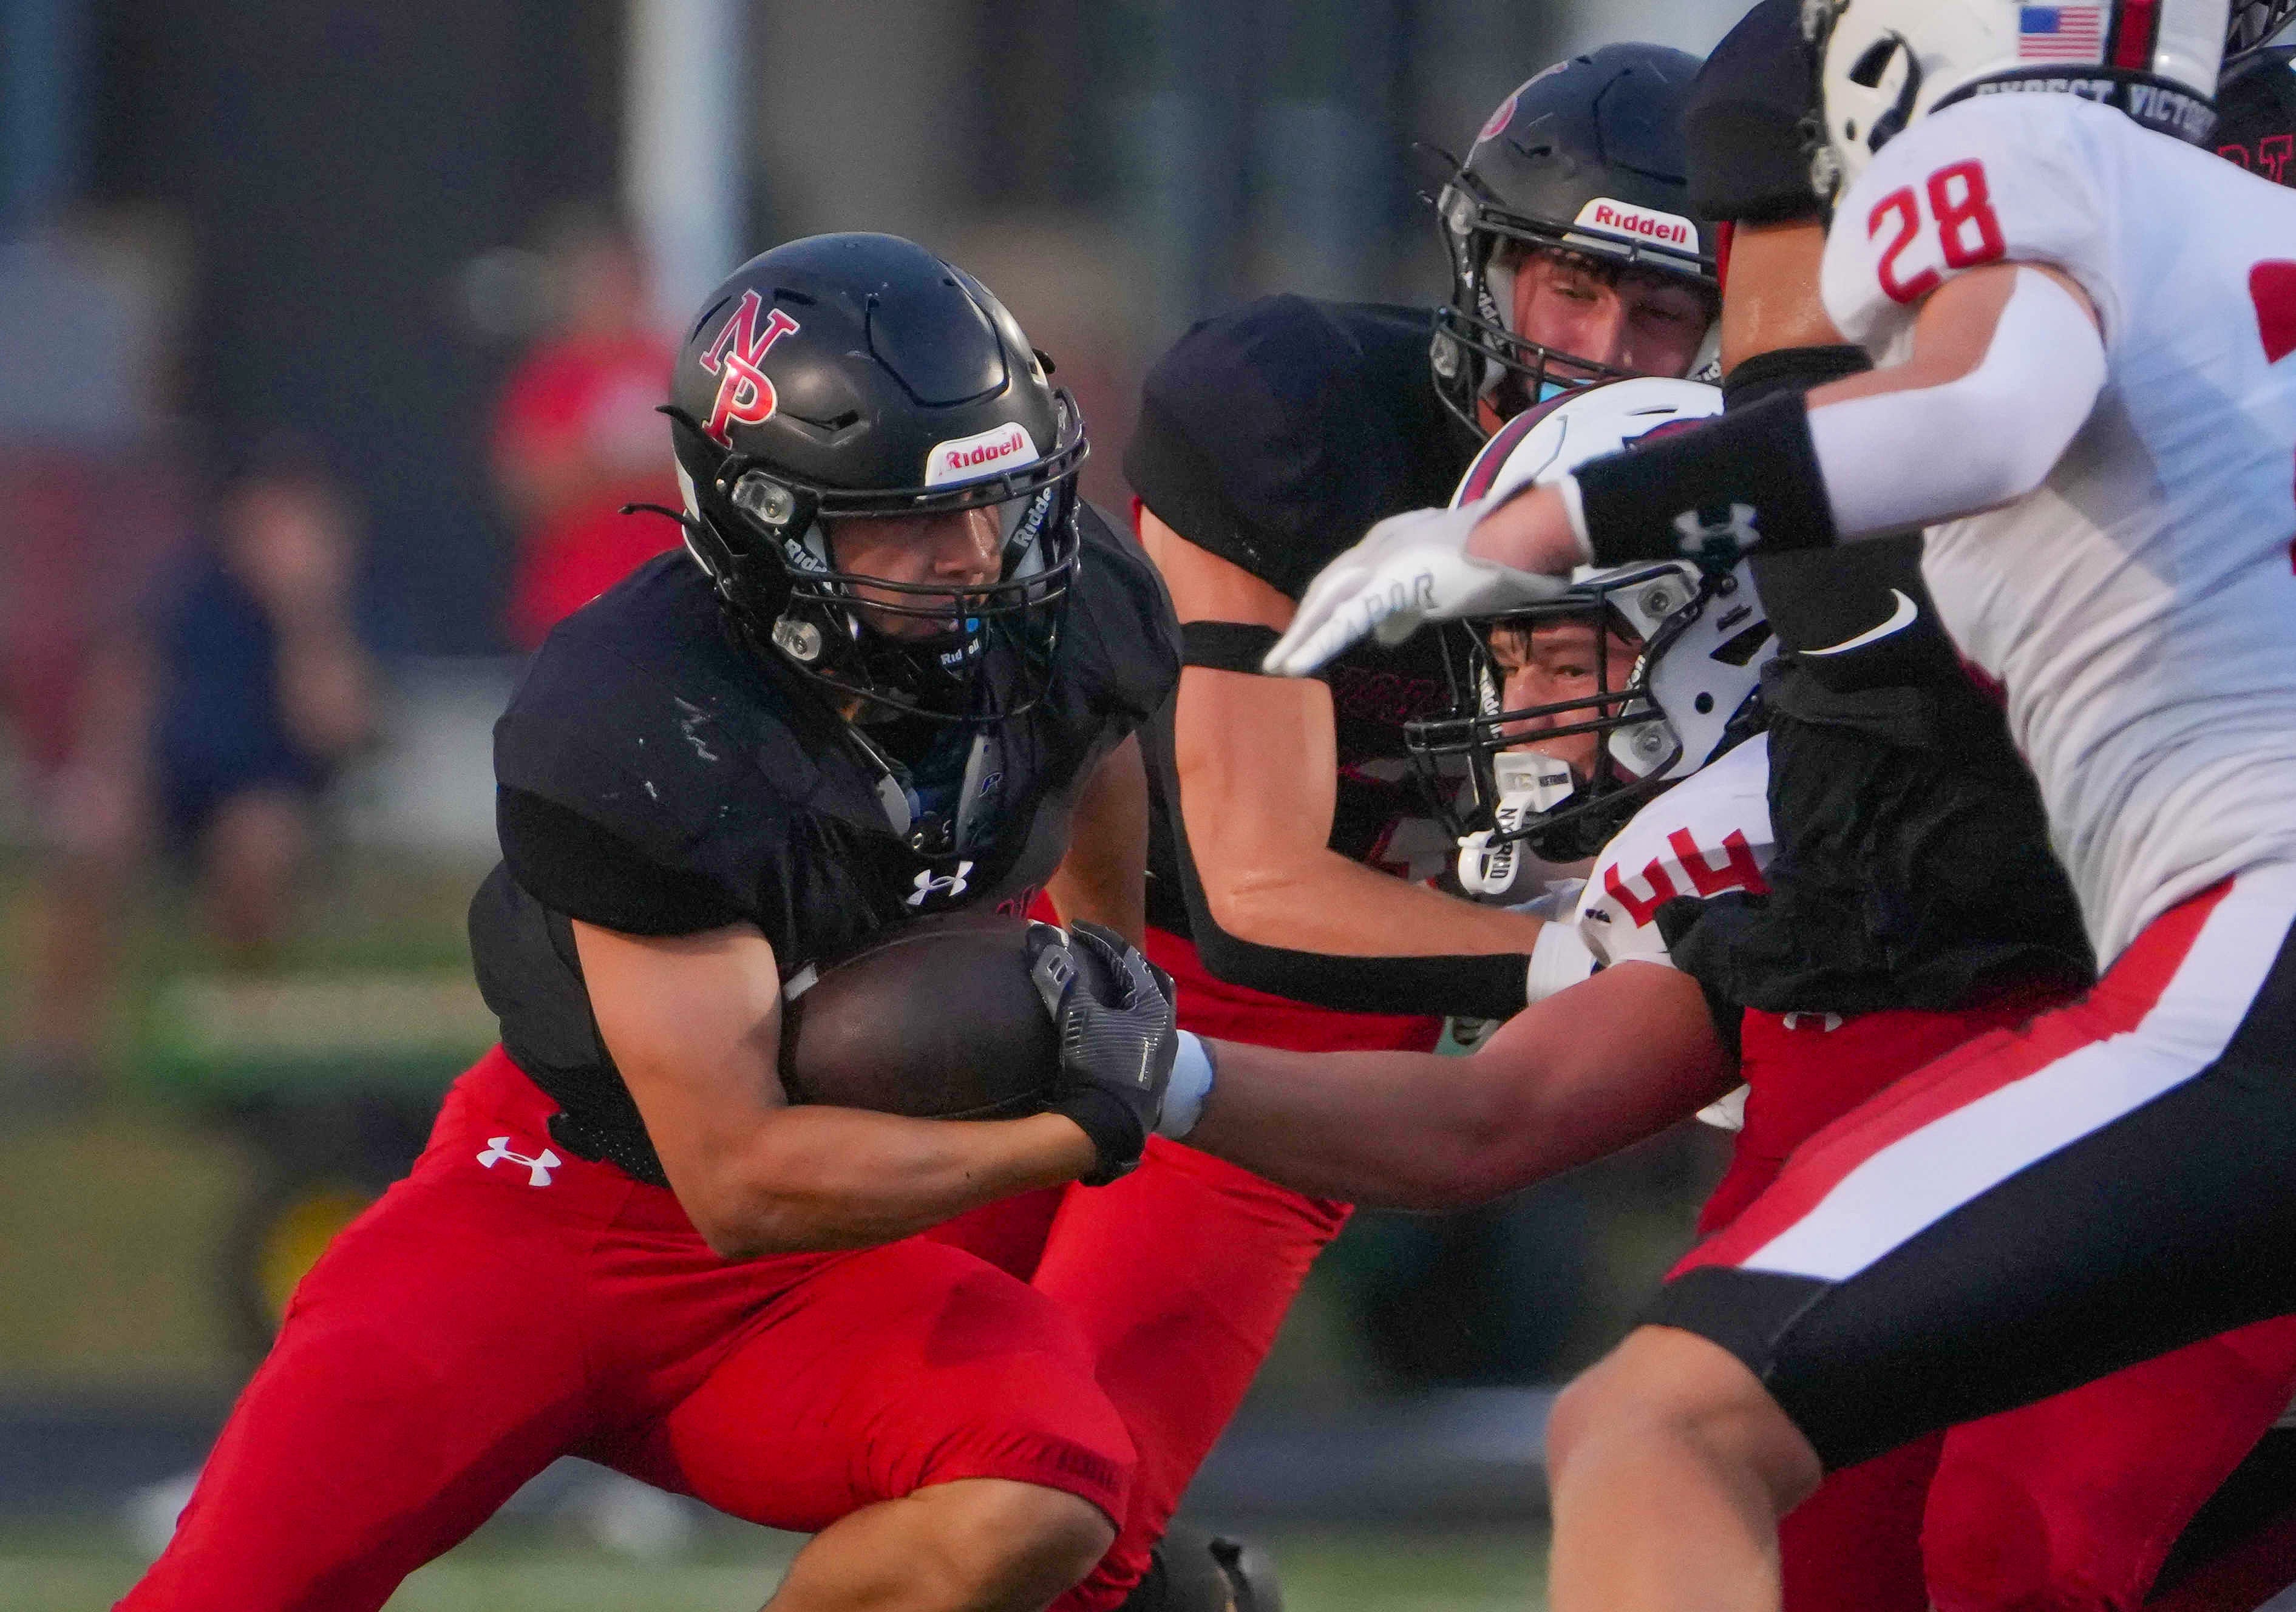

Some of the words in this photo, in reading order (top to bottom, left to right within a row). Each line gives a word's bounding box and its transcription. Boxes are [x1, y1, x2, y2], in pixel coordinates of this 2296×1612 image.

[1595, 205, 1687, 244] Riddell
[1867, 158, 2006, 304] 28
[699, 288, 801, 450] NP
[940, 638, 980, 665] Ridell
